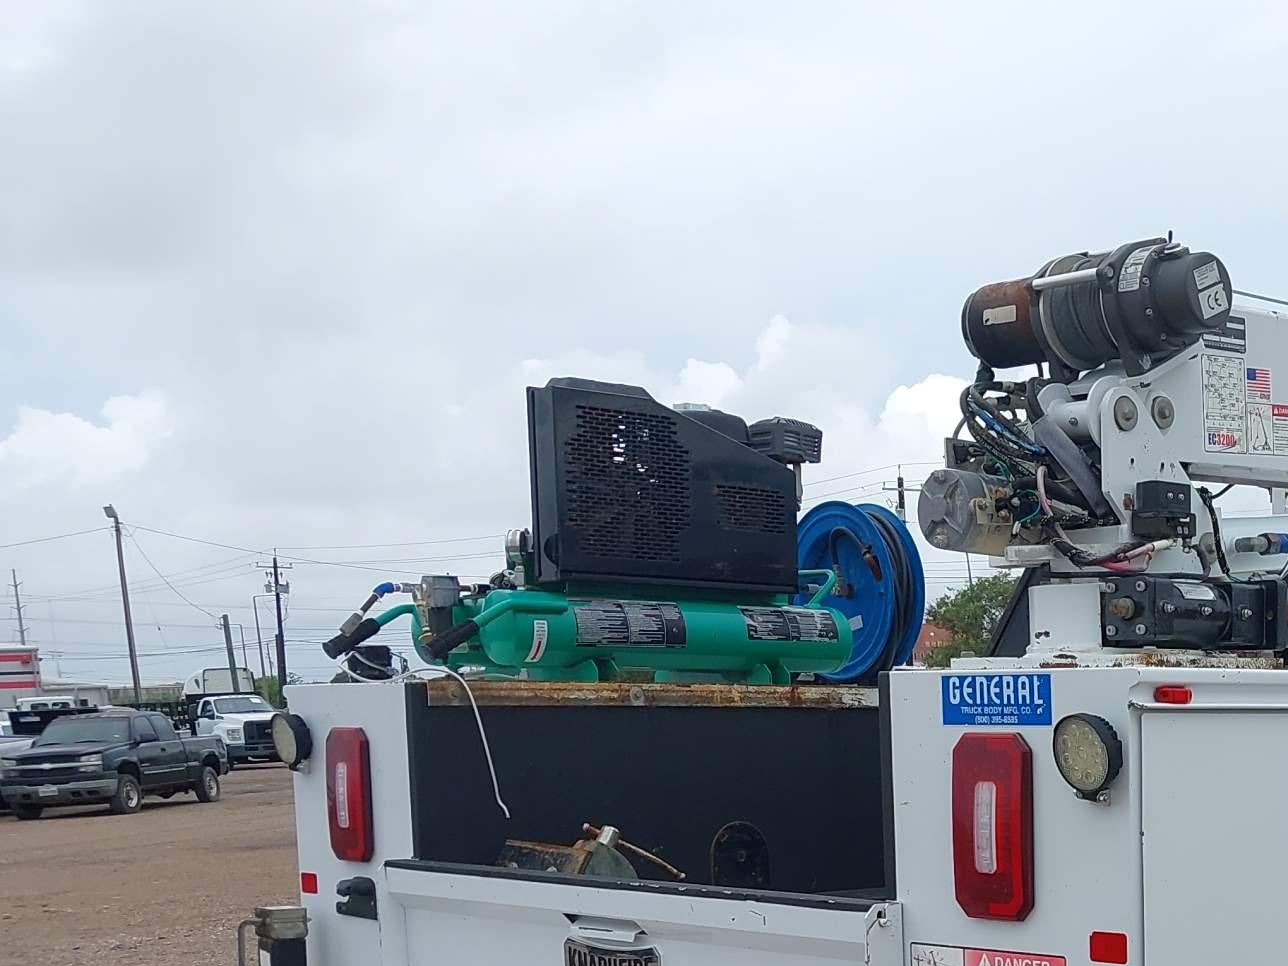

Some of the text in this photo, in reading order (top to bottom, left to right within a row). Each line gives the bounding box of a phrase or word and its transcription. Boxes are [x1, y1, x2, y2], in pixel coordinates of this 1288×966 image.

[1207, 432, 1236, 447] EC3200
[949, 674, 1044, 705] GENERAL
[960, 706, 983, 715] TRUCK
[983, 706, 1002, 715] BODY
[1021, 706, 1033, 715] CO.
